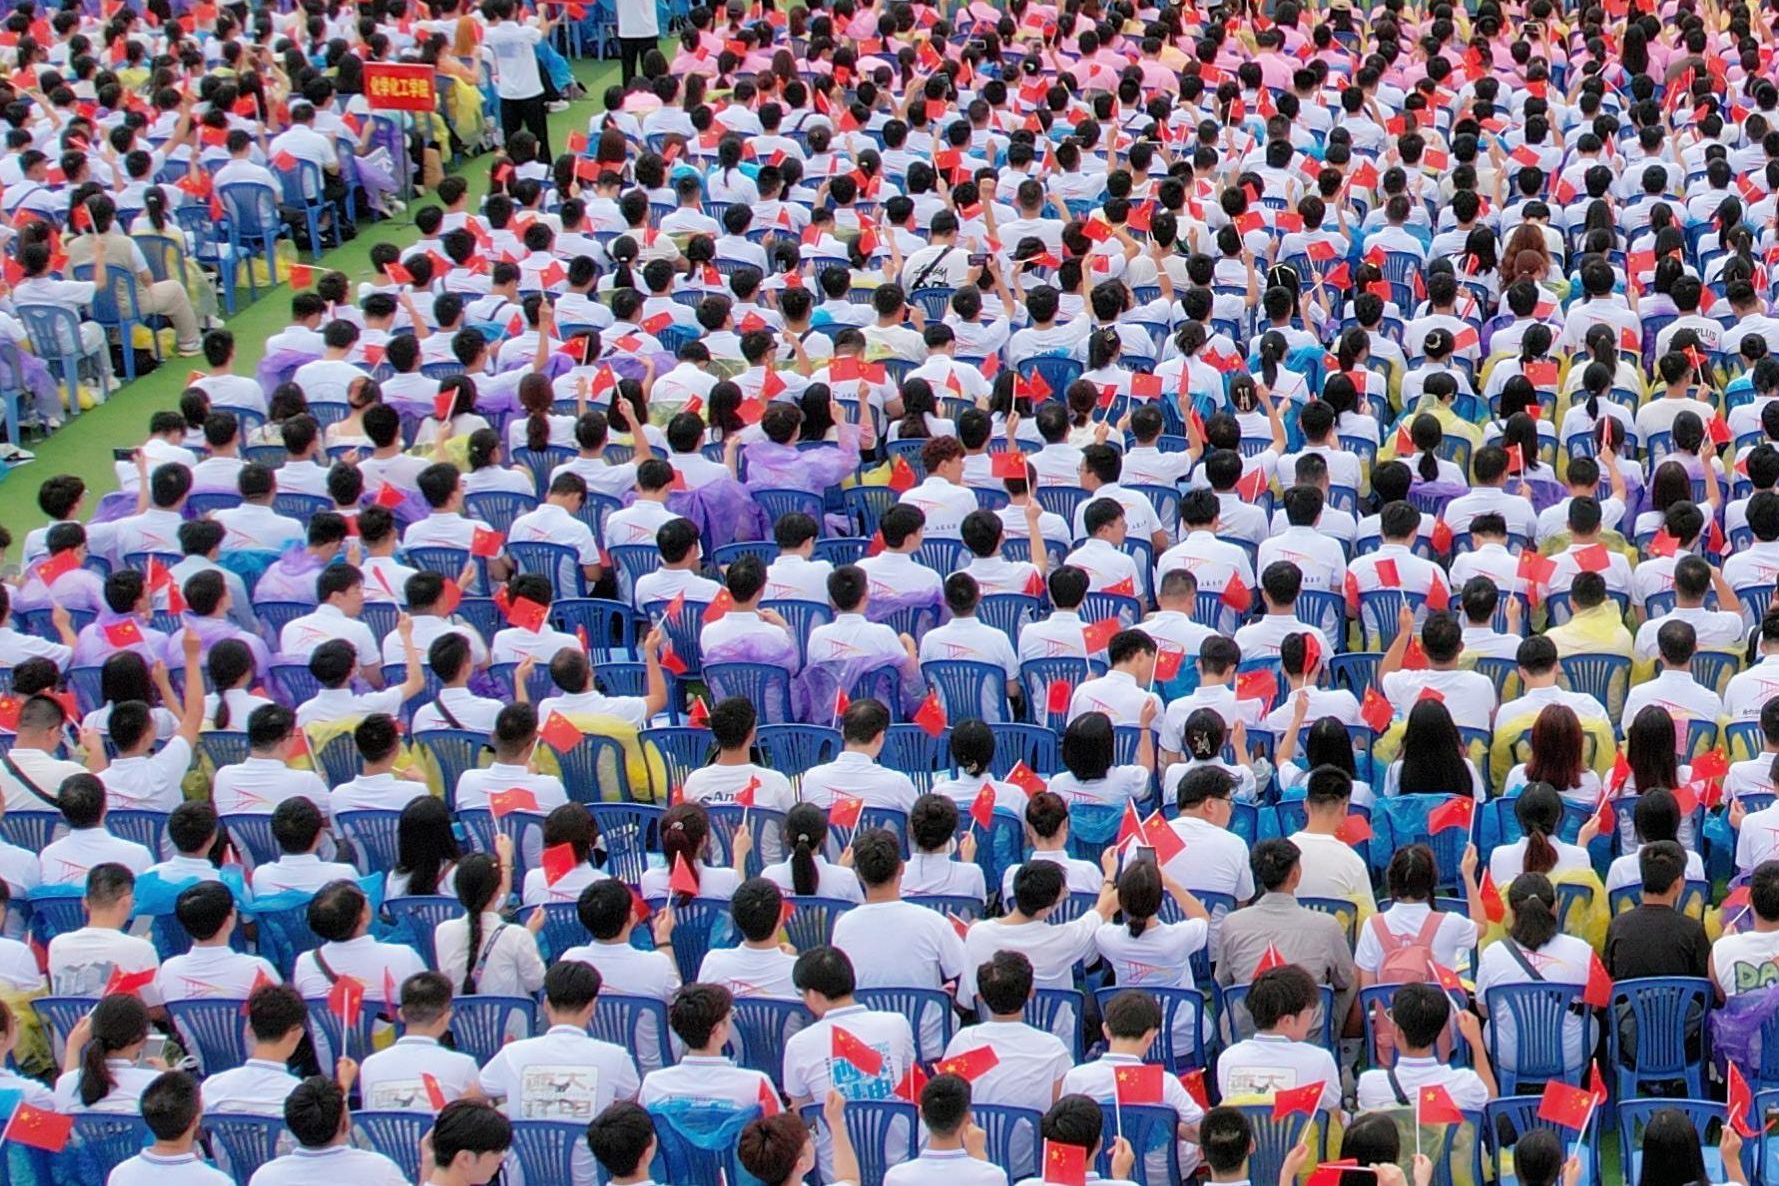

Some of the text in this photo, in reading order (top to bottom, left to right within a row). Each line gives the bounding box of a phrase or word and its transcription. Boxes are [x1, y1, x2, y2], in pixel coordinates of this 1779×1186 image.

[370, 76, 431, 98] 化学化工学院
